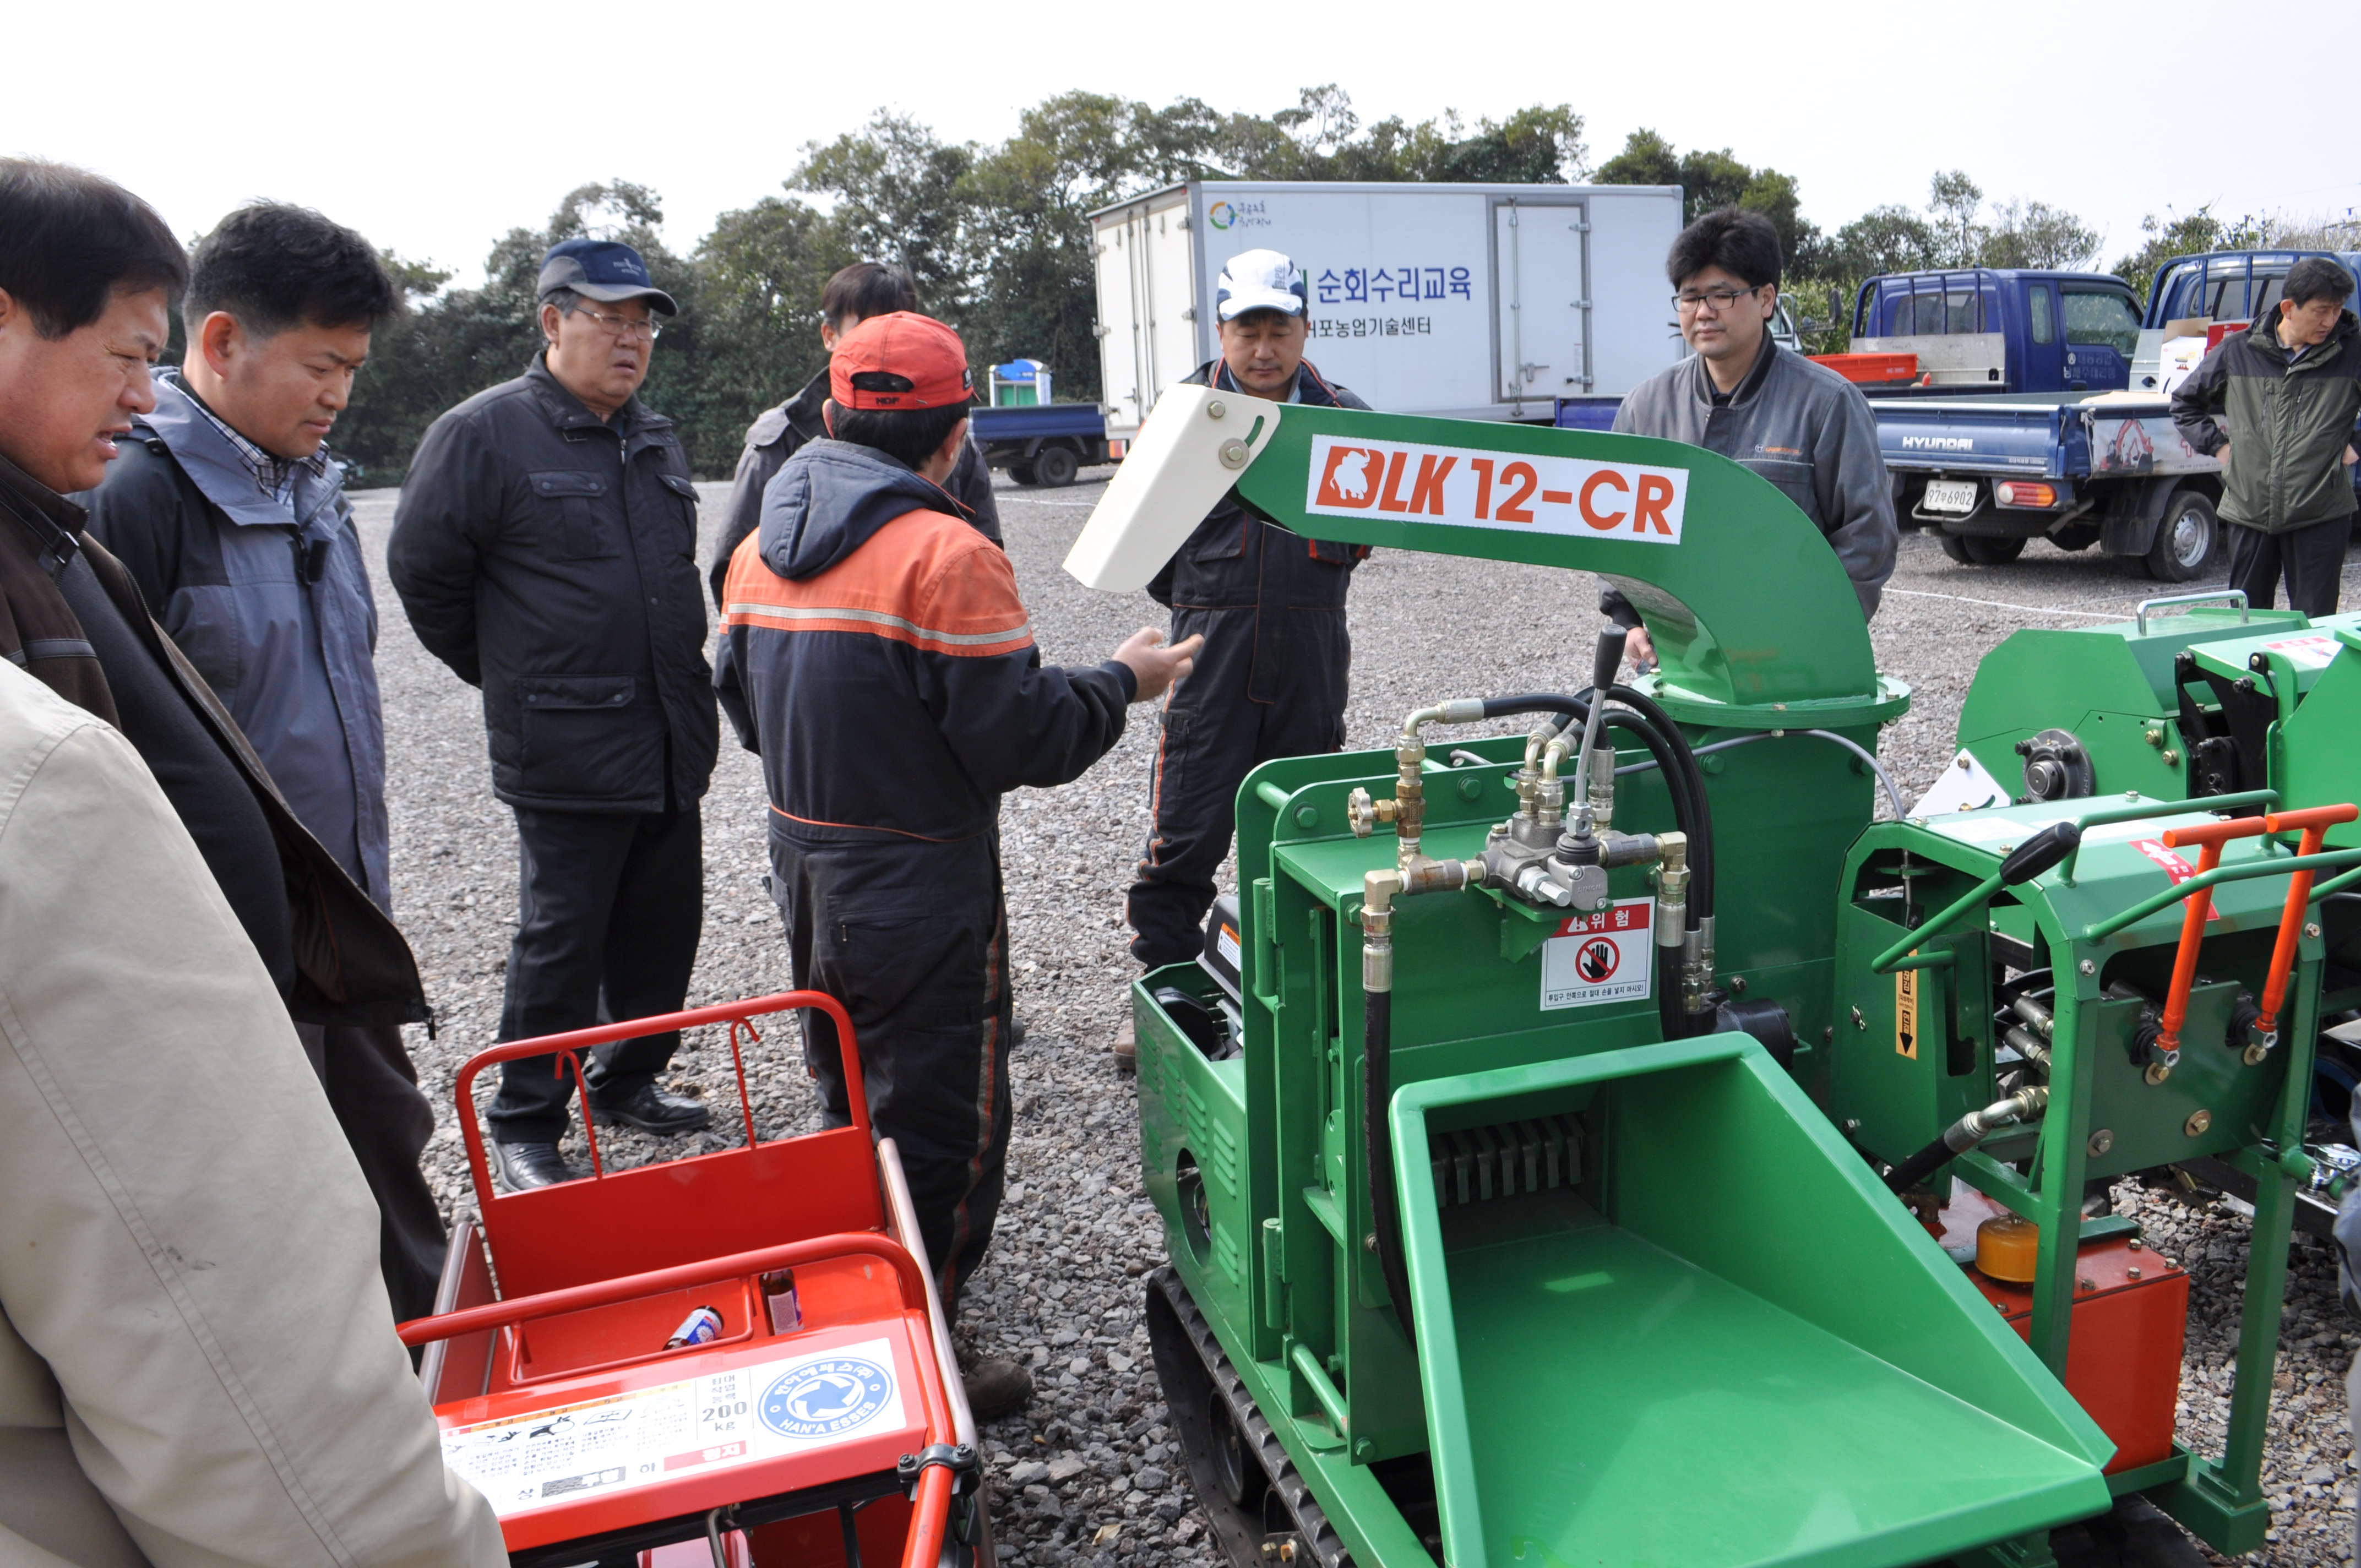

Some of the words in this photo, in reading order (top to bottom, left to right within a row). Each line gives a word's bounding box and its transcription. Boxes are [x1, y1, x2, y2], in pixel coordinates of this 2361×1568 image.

[1318, 267, 1471, 303] 순회수리교육
[1902, 436, 1973, 450] HYUNDAI
[1315, 445, 1458, 515] DLK
[1471, 458, 1674, 535] 12-CR
[1548, 993, 1564, 1002] 투입구
[1566, 990, 1587, 1001] 안쪽으로
[1590, 989, 1600, 997] 절대
[1602, 987, 1612, 997] 손을
[1614, 987, 1625, 995] 넣지
[1626, 984, 1644, 993] 마시오!
[711, 1374, 735, 1385] 최대
[711, 1384, 736, 1393] 작업
[701, 1401, 747, 1422] 200
[779, 1418, 826, 1434] HAN'A
[830, 1401, 877, 1431] ESSES
[715, 1421, 736, 1432] kg
[702, 1442, 741, 1461] 정지
[640, 1462, 655, 1473] 하
[581, 1468, 619, 1487] 주행
[518, 1488, 534, 1500] 상
